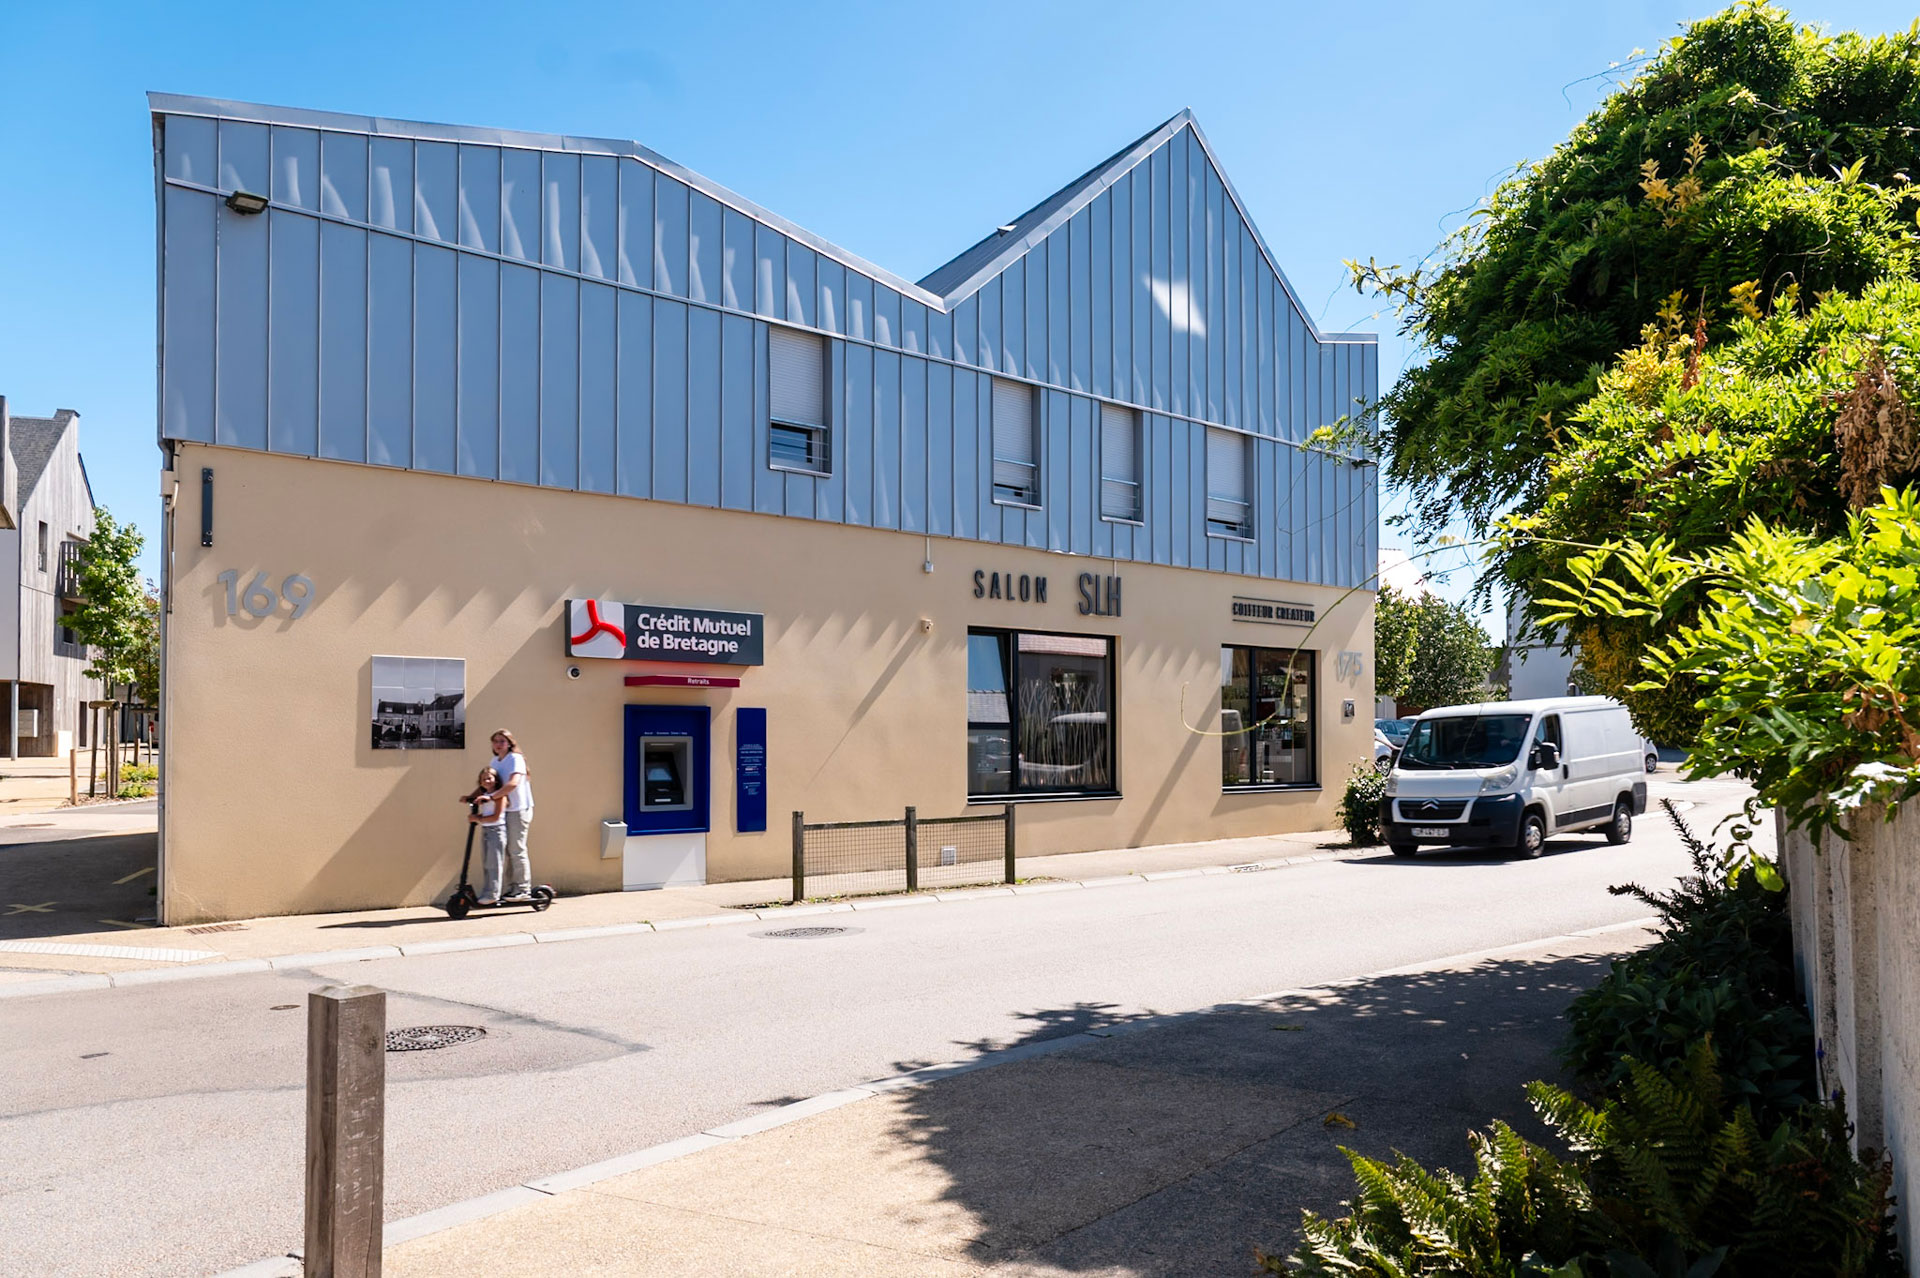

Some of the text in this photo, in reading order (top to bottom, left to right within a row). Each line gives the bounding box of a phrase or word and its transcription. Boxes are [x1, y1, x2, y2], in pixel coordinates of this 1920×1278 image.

[217, 568, 316, 620] 169
[974, 569, 1122, 617] SALON SLH
[637, 613, 751, 637] Crédit Mutuel
[637, 631, 739, 656] de Bretagne
[1337, 651, 1363, 676] 175
[687, 677, 710, 686] Retraits
